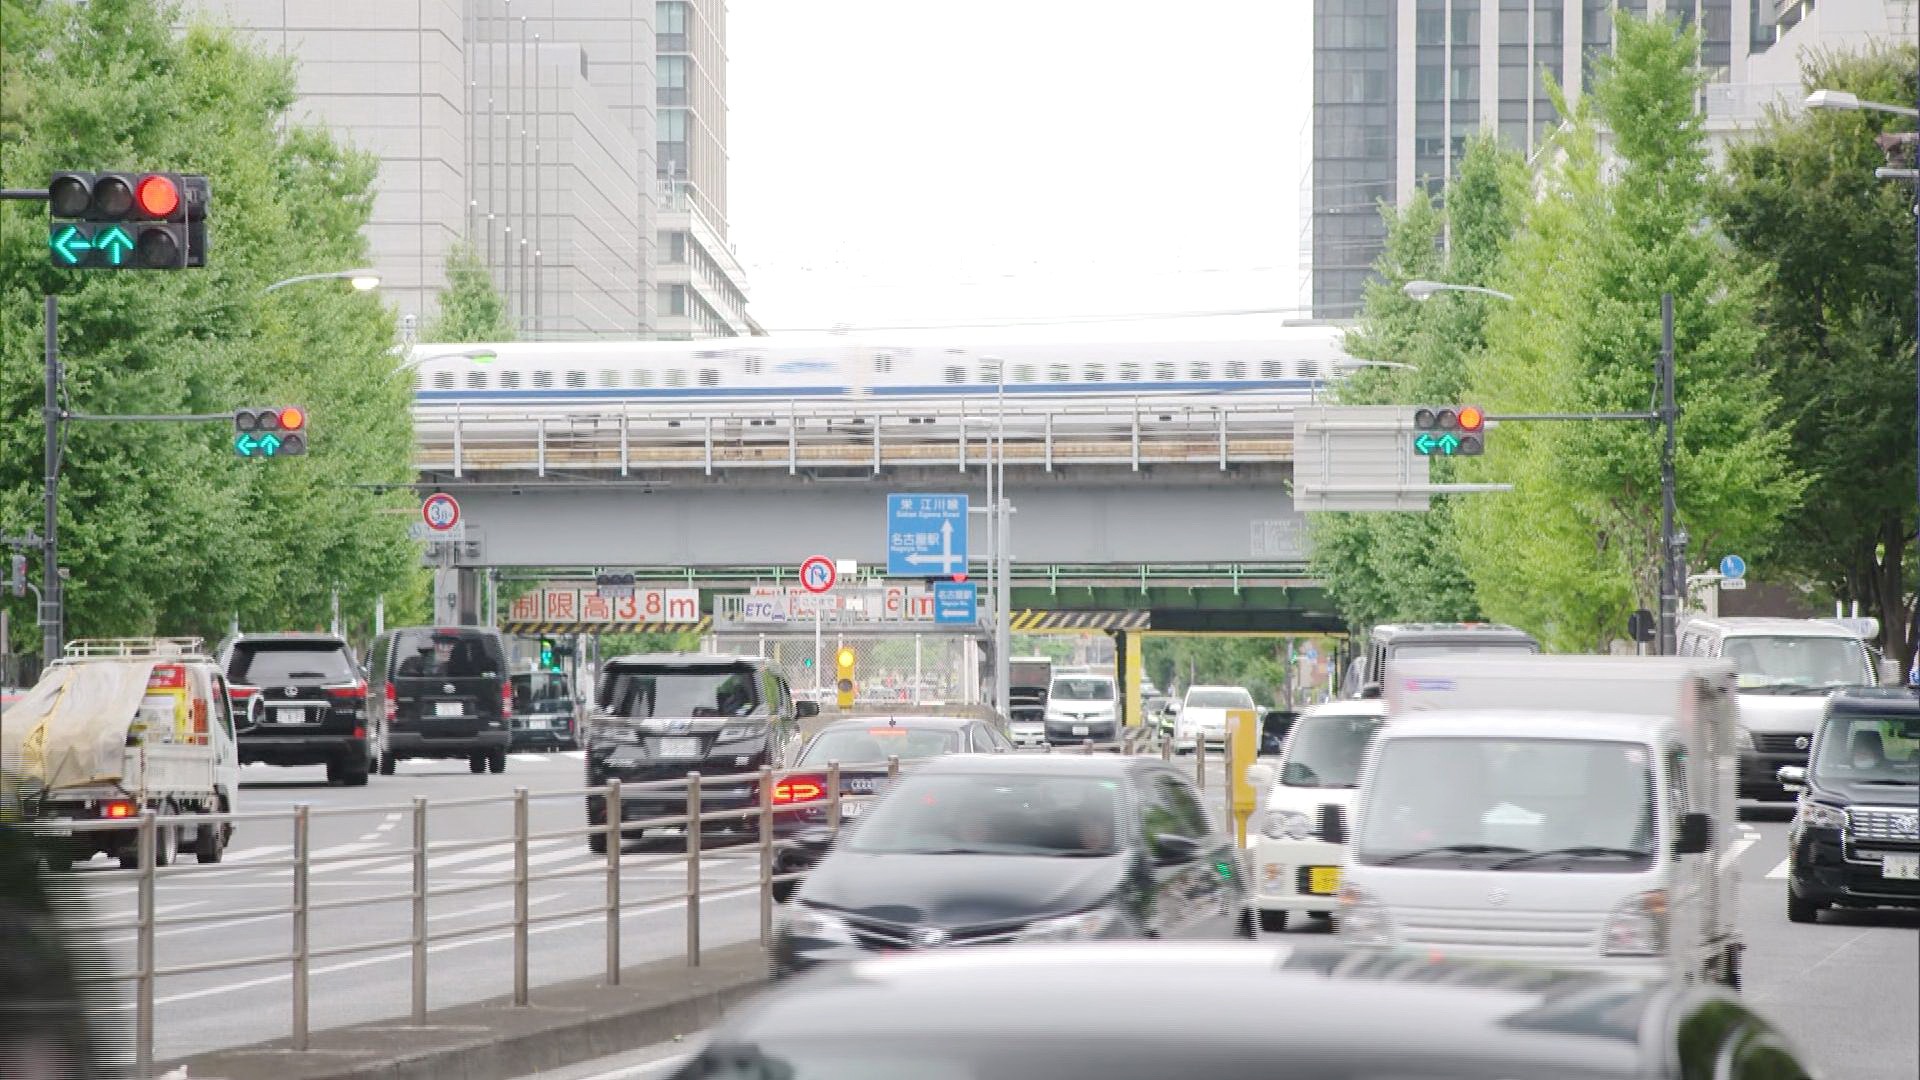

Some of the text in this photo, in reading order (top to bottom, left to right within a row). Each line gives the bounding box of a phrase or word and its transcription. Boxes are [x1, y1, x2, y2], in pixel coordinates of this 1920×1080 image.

[891, 532, 940, 546] 名古屋駅
[745, 603, 773, 617] ETC
